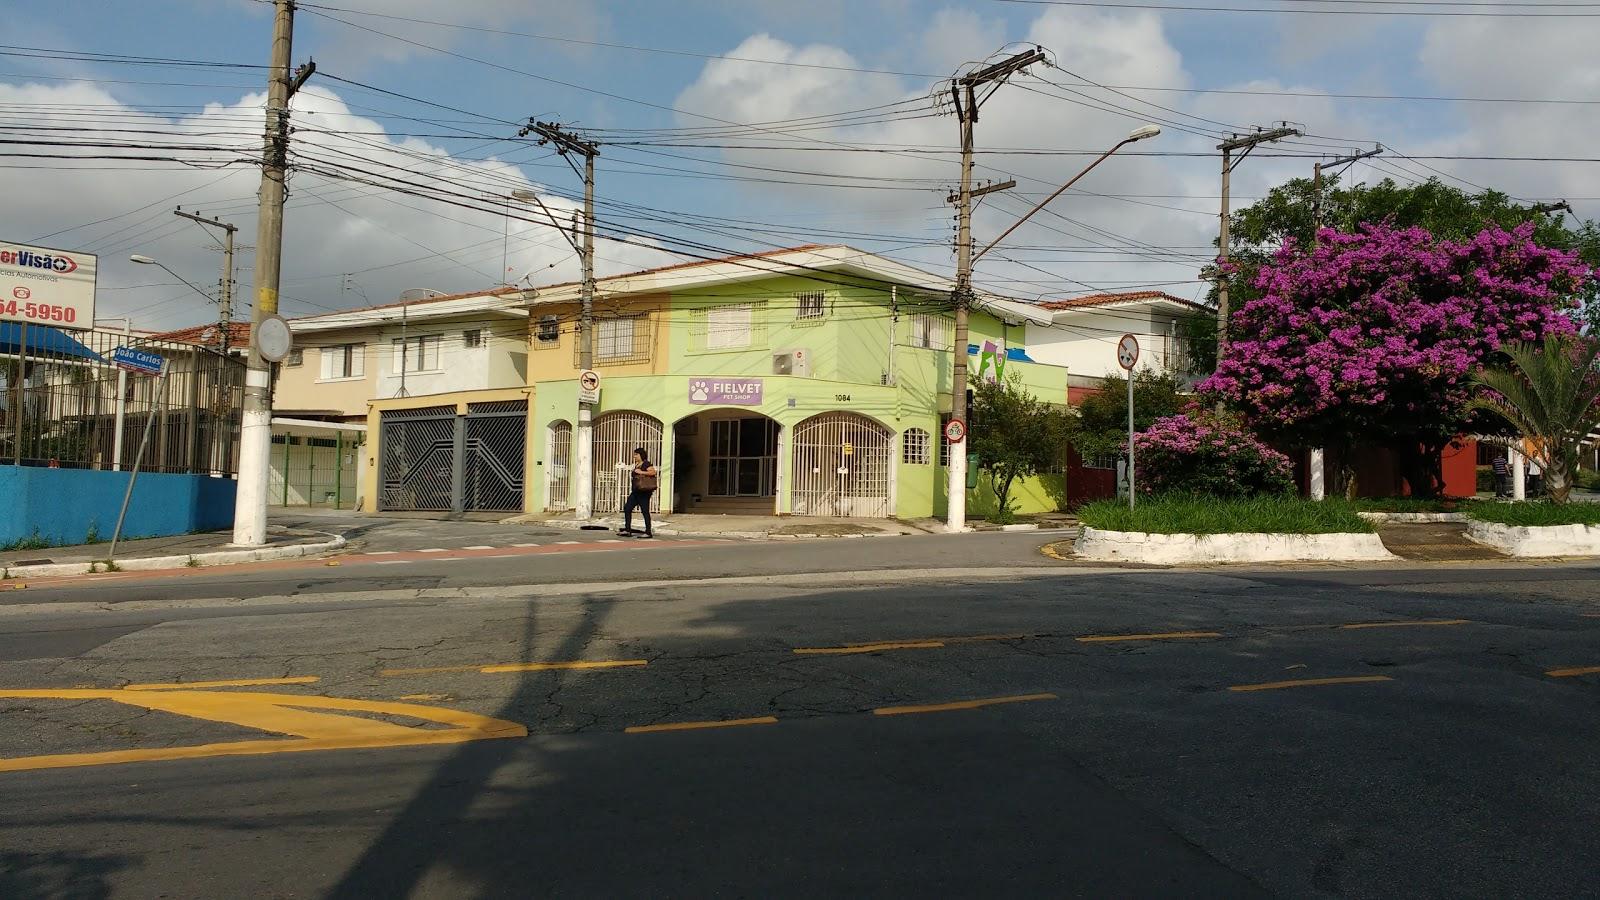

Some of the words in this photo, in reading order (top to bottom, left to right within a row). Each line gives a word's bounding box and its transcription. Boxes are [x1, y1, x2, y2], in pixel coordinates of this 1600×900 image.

[16, 270, 59, 282] Automotivas
[116, 348, 135, 359] João
[136, 352, 161, 366] Carlos
[713, 383, 761, 394] FIELVET
[835, 394, 851, 402] 1084
